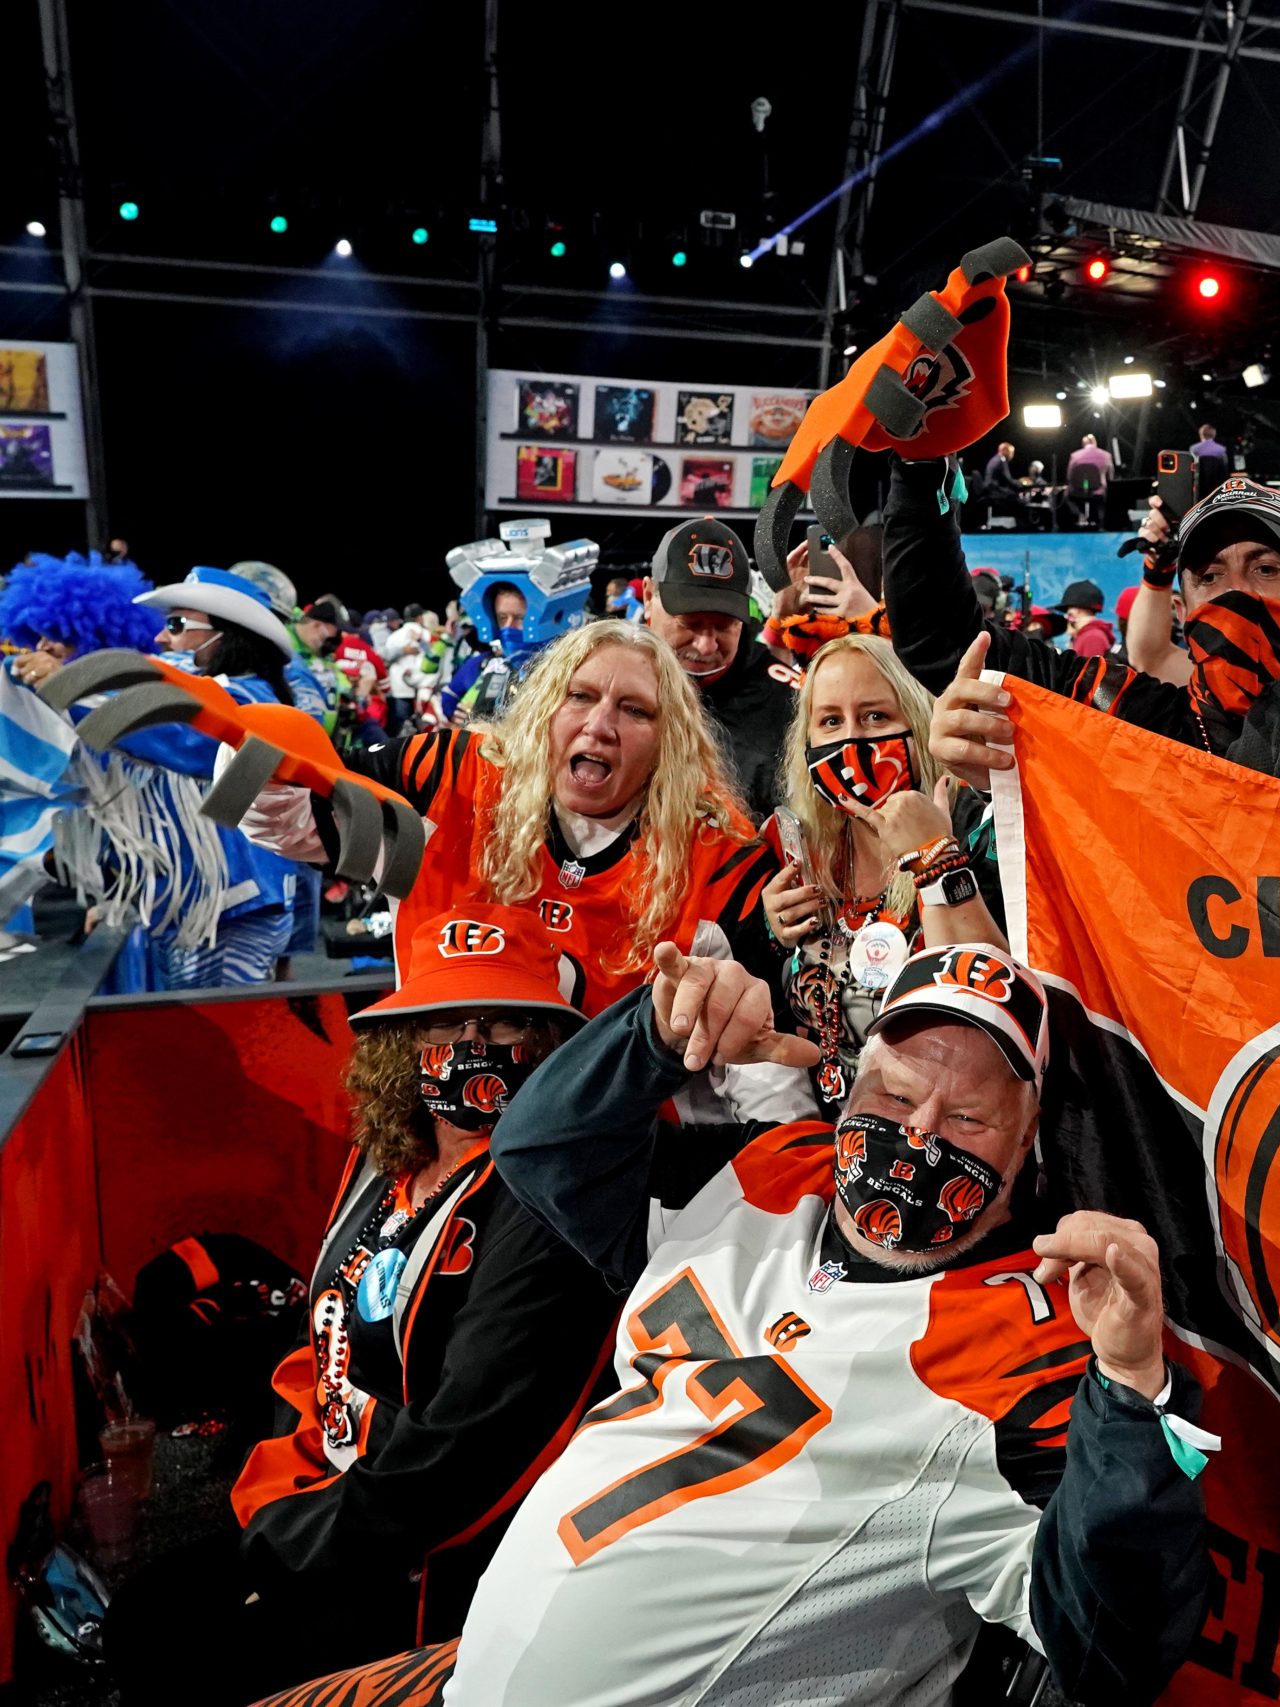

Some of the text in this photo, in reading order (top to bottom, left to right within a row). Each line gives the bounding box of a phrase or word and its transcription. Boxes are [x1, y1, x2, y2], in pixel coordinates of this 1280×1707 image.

[539, 898, 574, 933] B
[437, 919, 506, 959] B
[932, 949, 1016, 1003] B
[866, 1176, 924, 1208] BENGALS
[811, 1269, 831, 1292] NFL
[557, 1265, 833, 1568] 77
